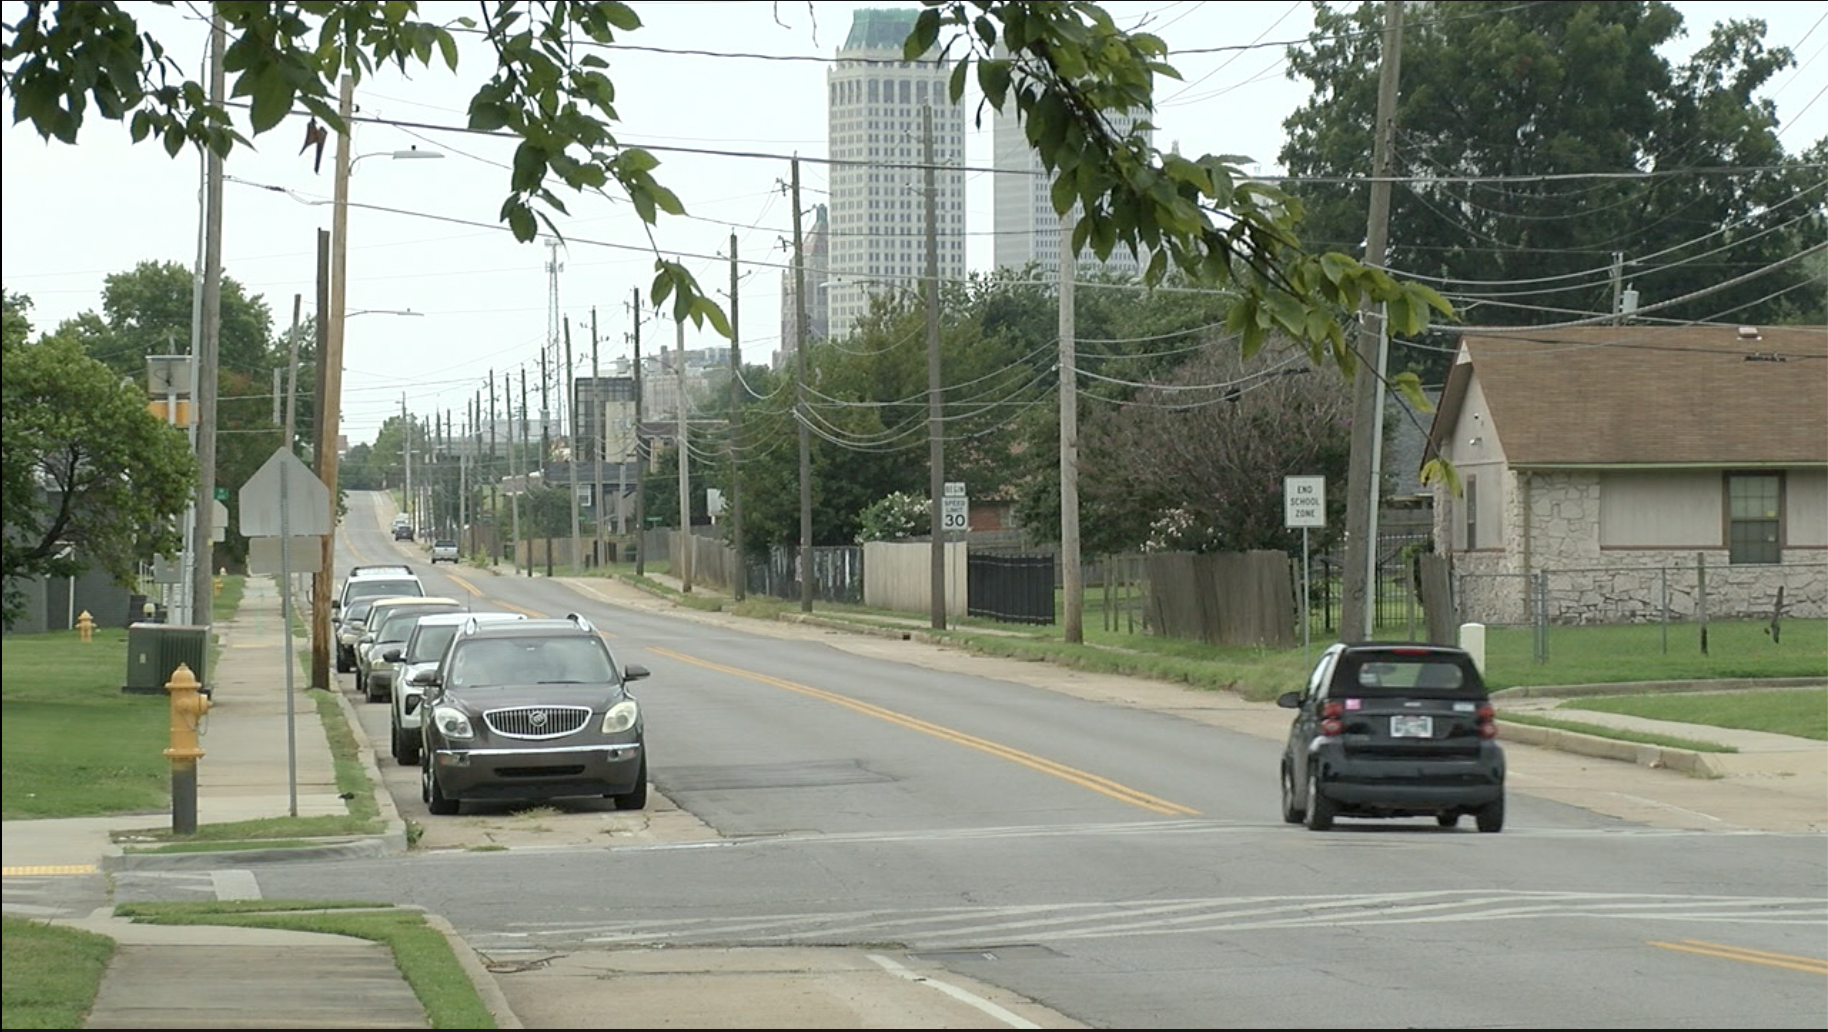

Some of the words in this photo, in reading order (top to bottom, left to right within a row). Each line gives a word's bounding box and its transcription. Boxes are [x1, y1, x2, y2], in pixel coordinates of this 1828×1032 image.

[1297, 485, 1314, 494] END
[1291, 497, 1320, 506] SCHOOL
[1295, 509, 1316, 518] ZONE
[945, 514, 966, 527] 30
